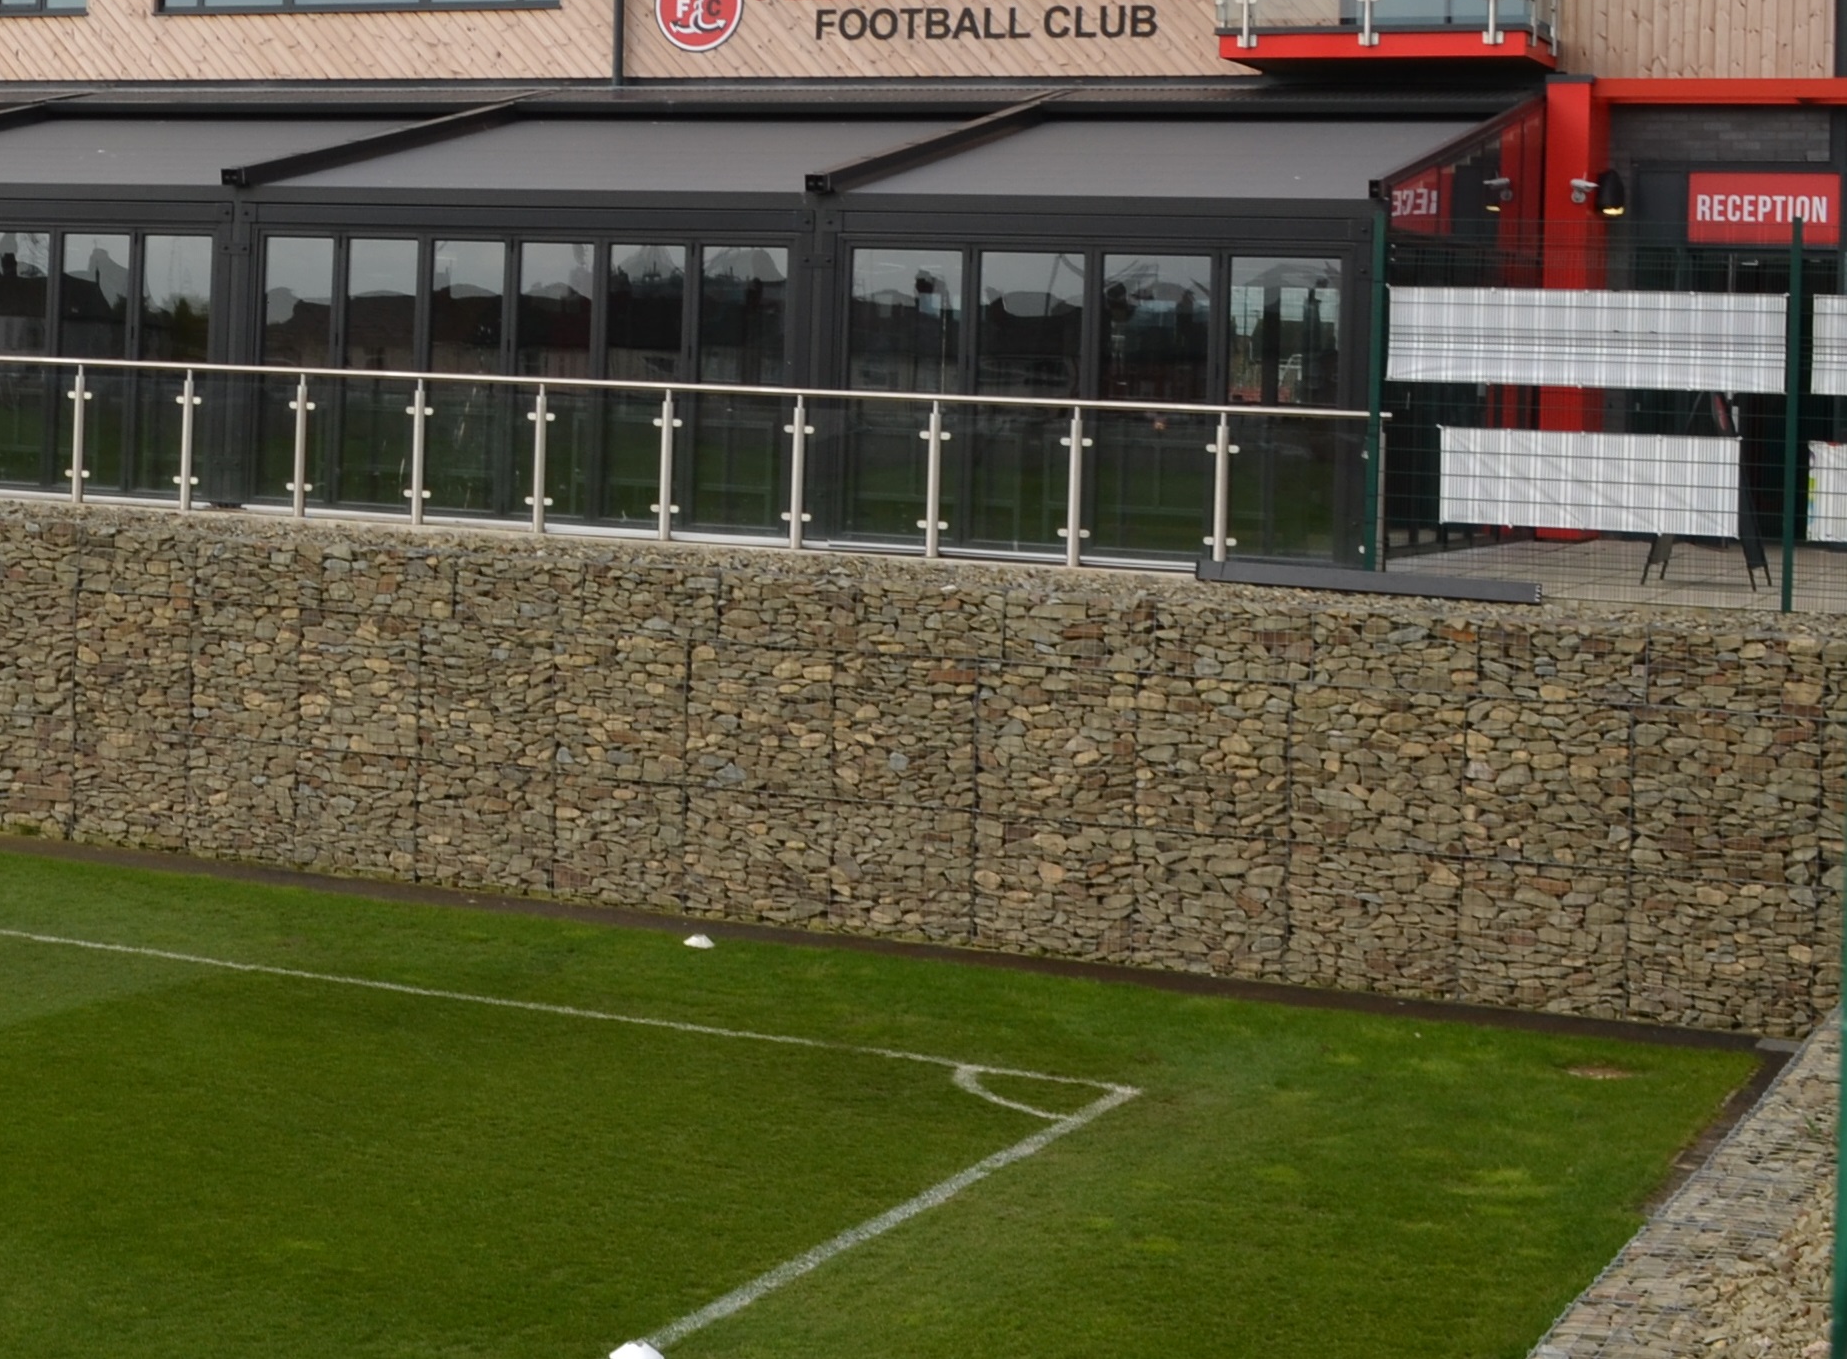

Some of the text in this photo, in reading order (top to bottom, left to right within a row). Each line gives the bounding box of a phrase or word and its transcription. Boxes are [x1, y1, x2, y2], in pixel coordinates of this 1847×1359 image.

[815, 5, 1158, 40] FOOTBALL CLUB
[1696, 194, 1827, 223] RECEPTION
